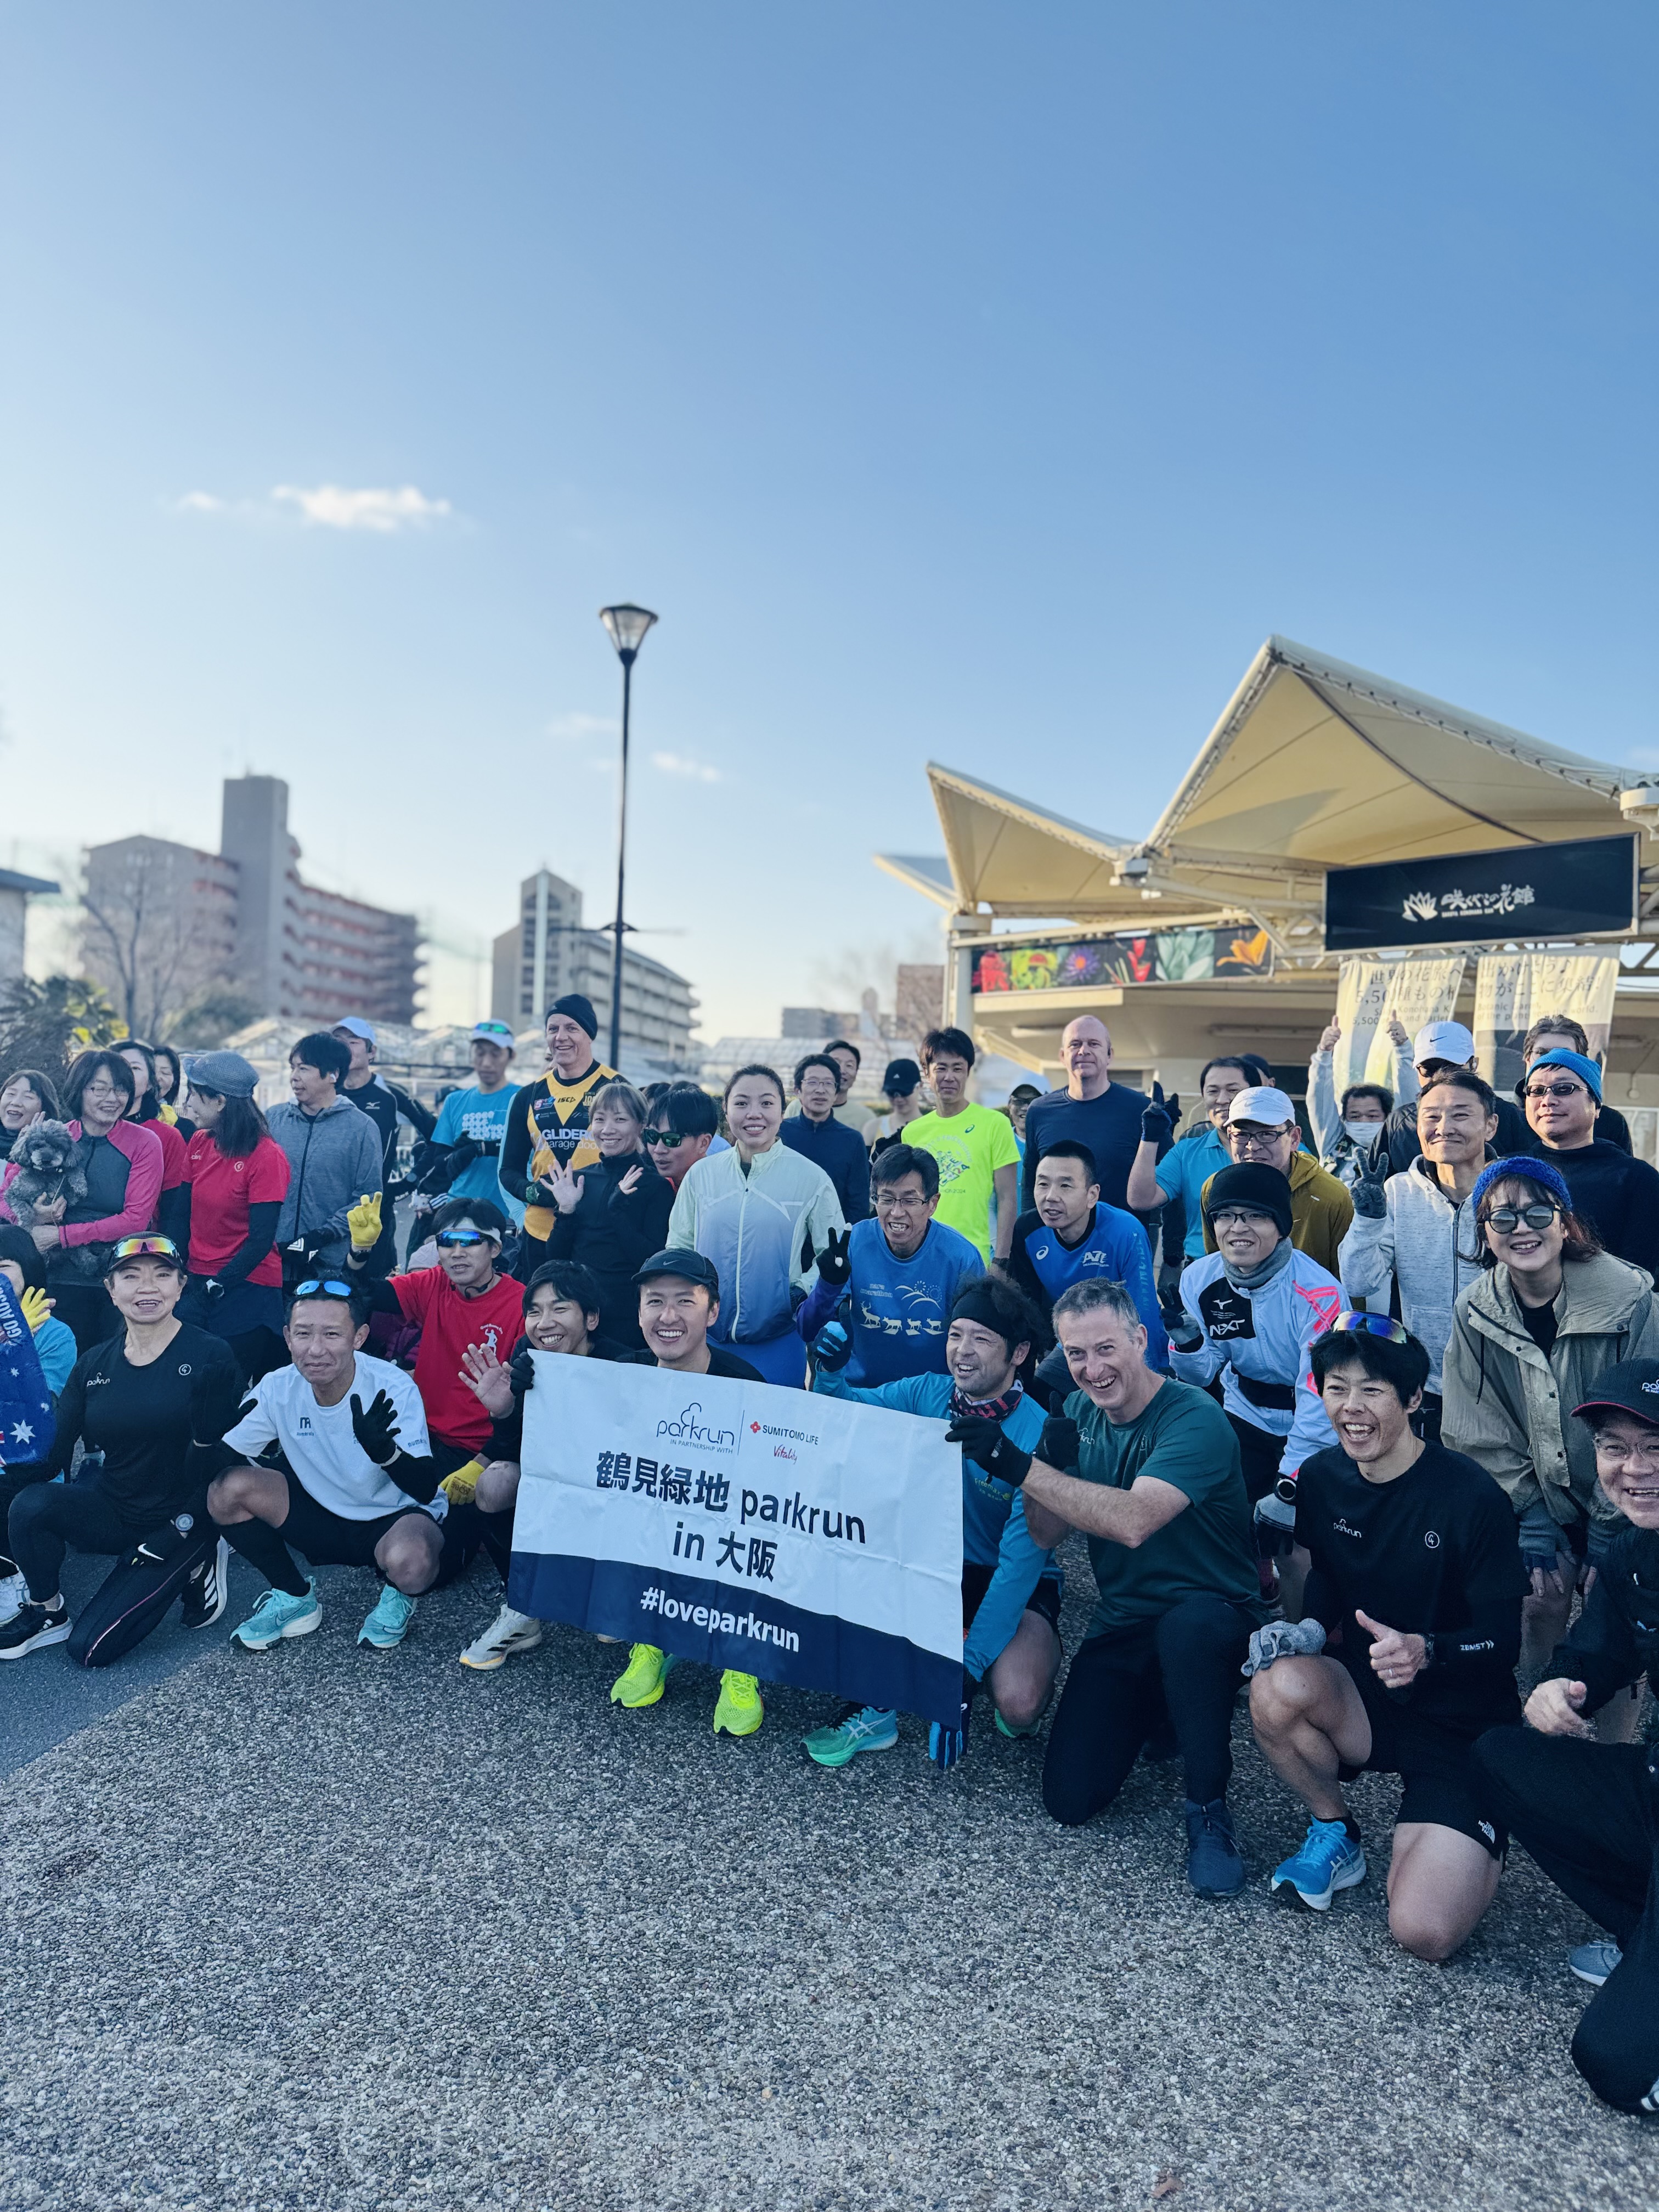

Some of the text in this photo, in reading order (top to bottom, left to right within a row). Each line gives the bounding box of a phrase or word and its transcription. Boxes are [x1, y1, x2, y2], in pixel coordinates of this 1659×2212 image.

[1441, 884, 1535, 915] 咲くやこの花館
[3, 1320, 22, 1338] GO
[656, 1402, 734, 1446] parkrun
[763, 1425, 819, 1446] SUMITOMO LIFE
[678, 1441, 715, 1451] PARTNERSHIP
[774, 1444, 798, 1465] Vitality
[596, 1451, 866, 1544] 鶴見緑地 parkrun
[673, 1521, 778, 1583] in 大阪
[640, 1586, 800, 1652] #loveparkrun
